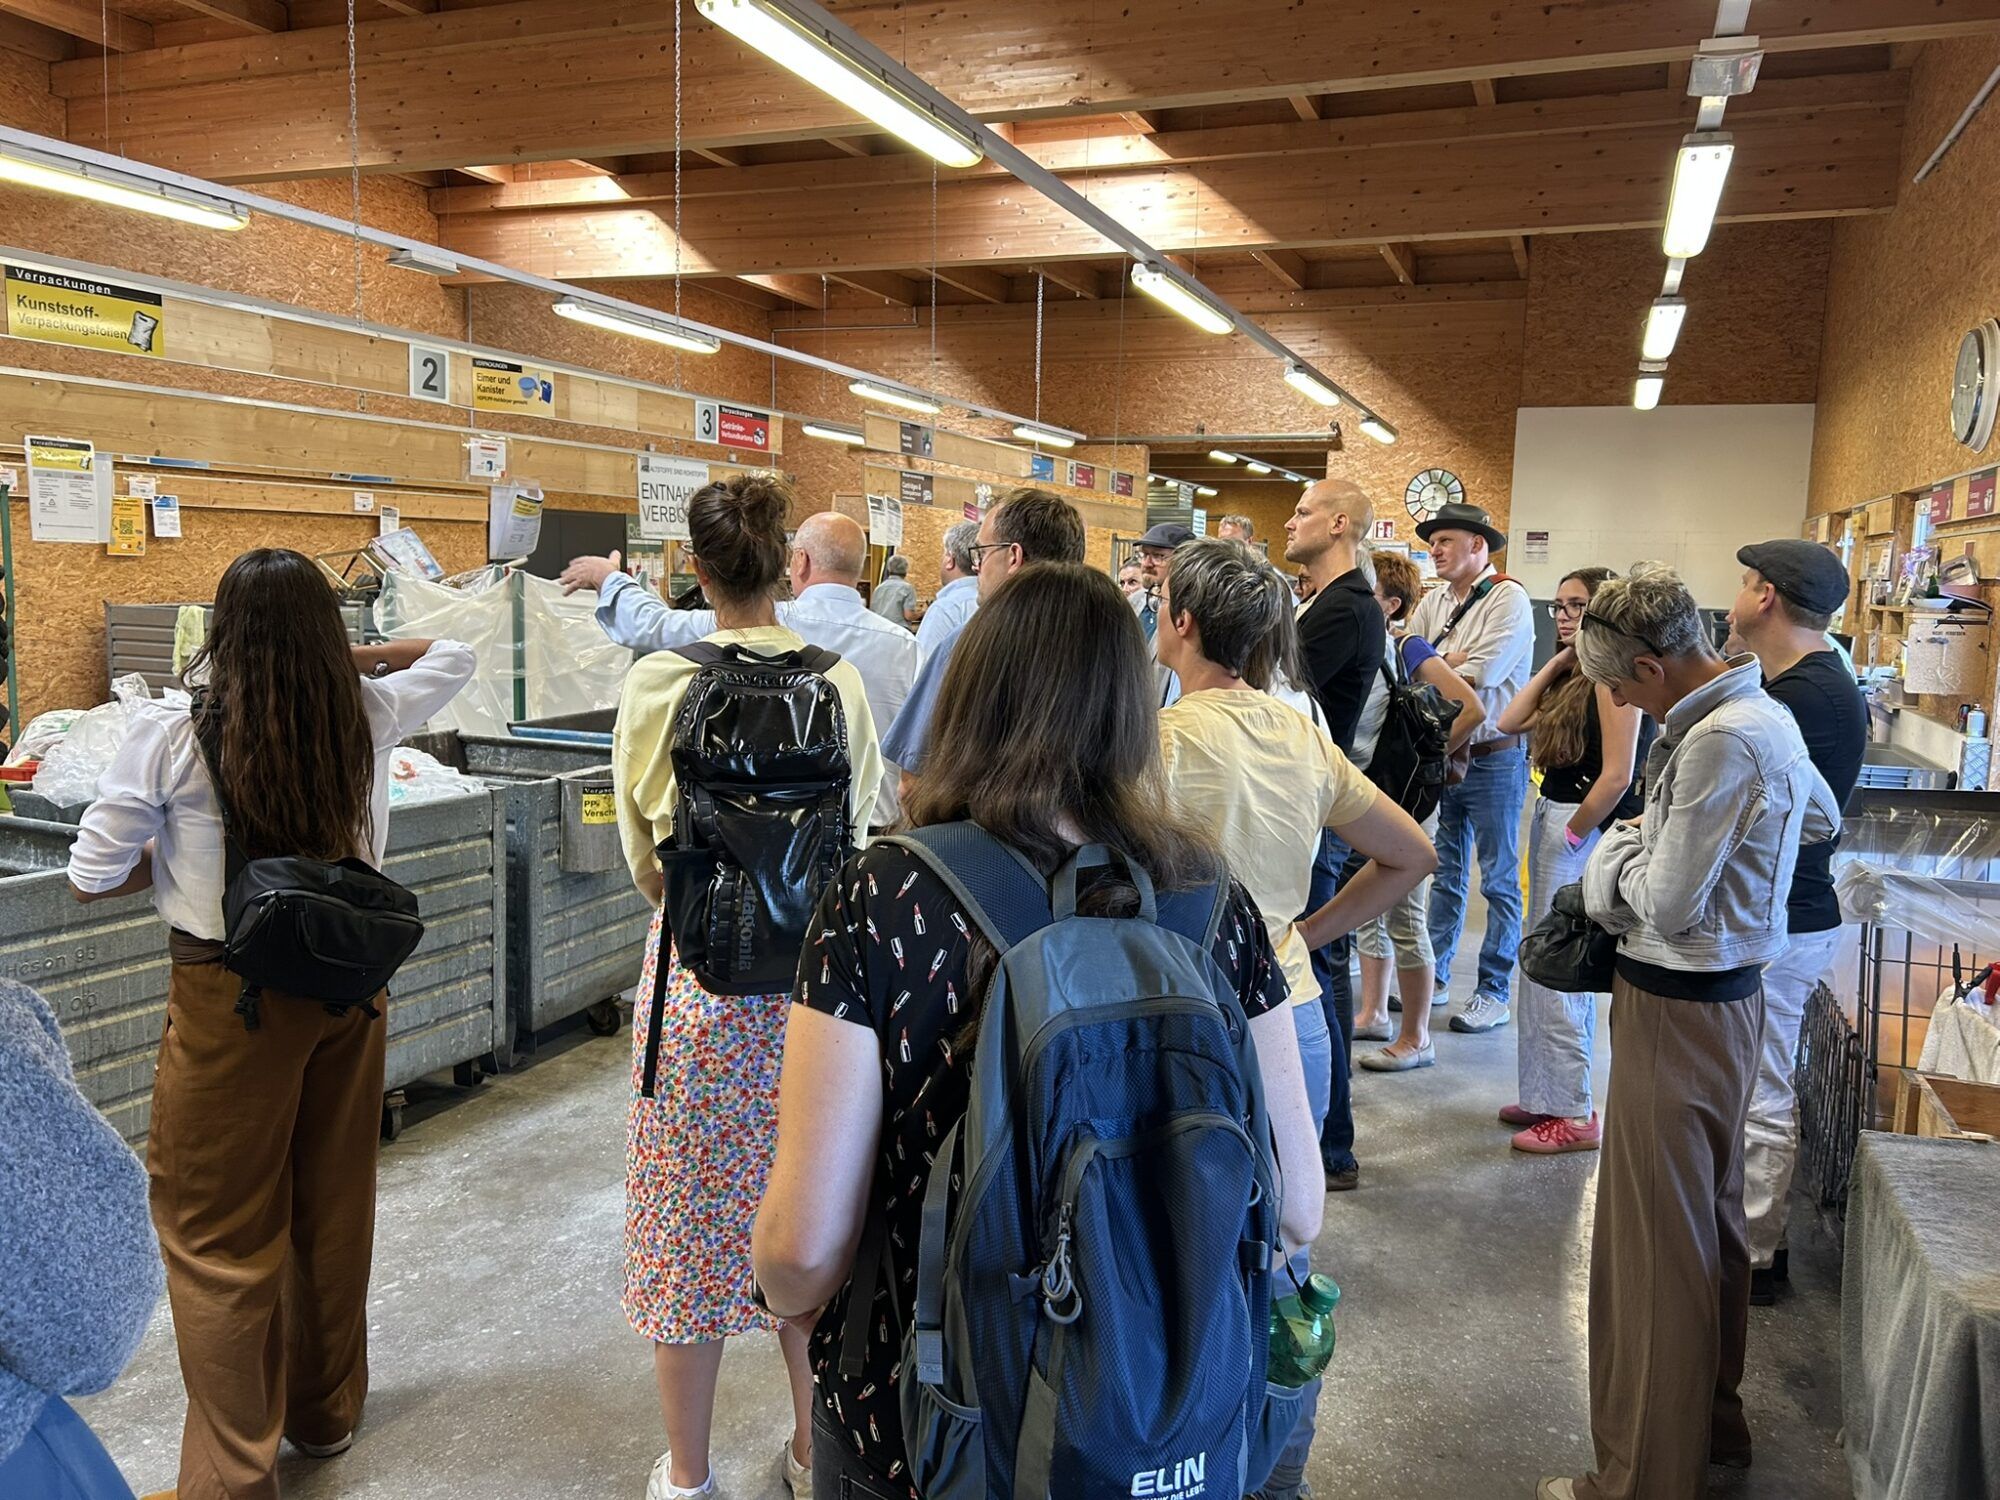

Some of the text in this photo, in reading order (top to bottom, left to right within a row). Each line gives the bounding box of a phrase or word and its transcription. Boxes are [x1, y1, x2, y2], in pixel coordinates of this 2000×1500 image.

[15, 268, 111, 295] Verpackungen
[16, 294, 100, 319] Kunststoff-
[17, 312, 128, 340] Verpackungsfolien
[422, 357, 438, 392] 2
[476, 373, 511, 385] Eimer und
[476, 384, 505, 395] Kanister
[702, 409, 712, 435] 3
[721, 407, 753, 418] Verpackungen
[641, 504, 687, 524] VERBO
[627, 523, 641, 539] Re
[584, 809, 616, 817] Verschl
[738, 881, 759, 971] atagonia
